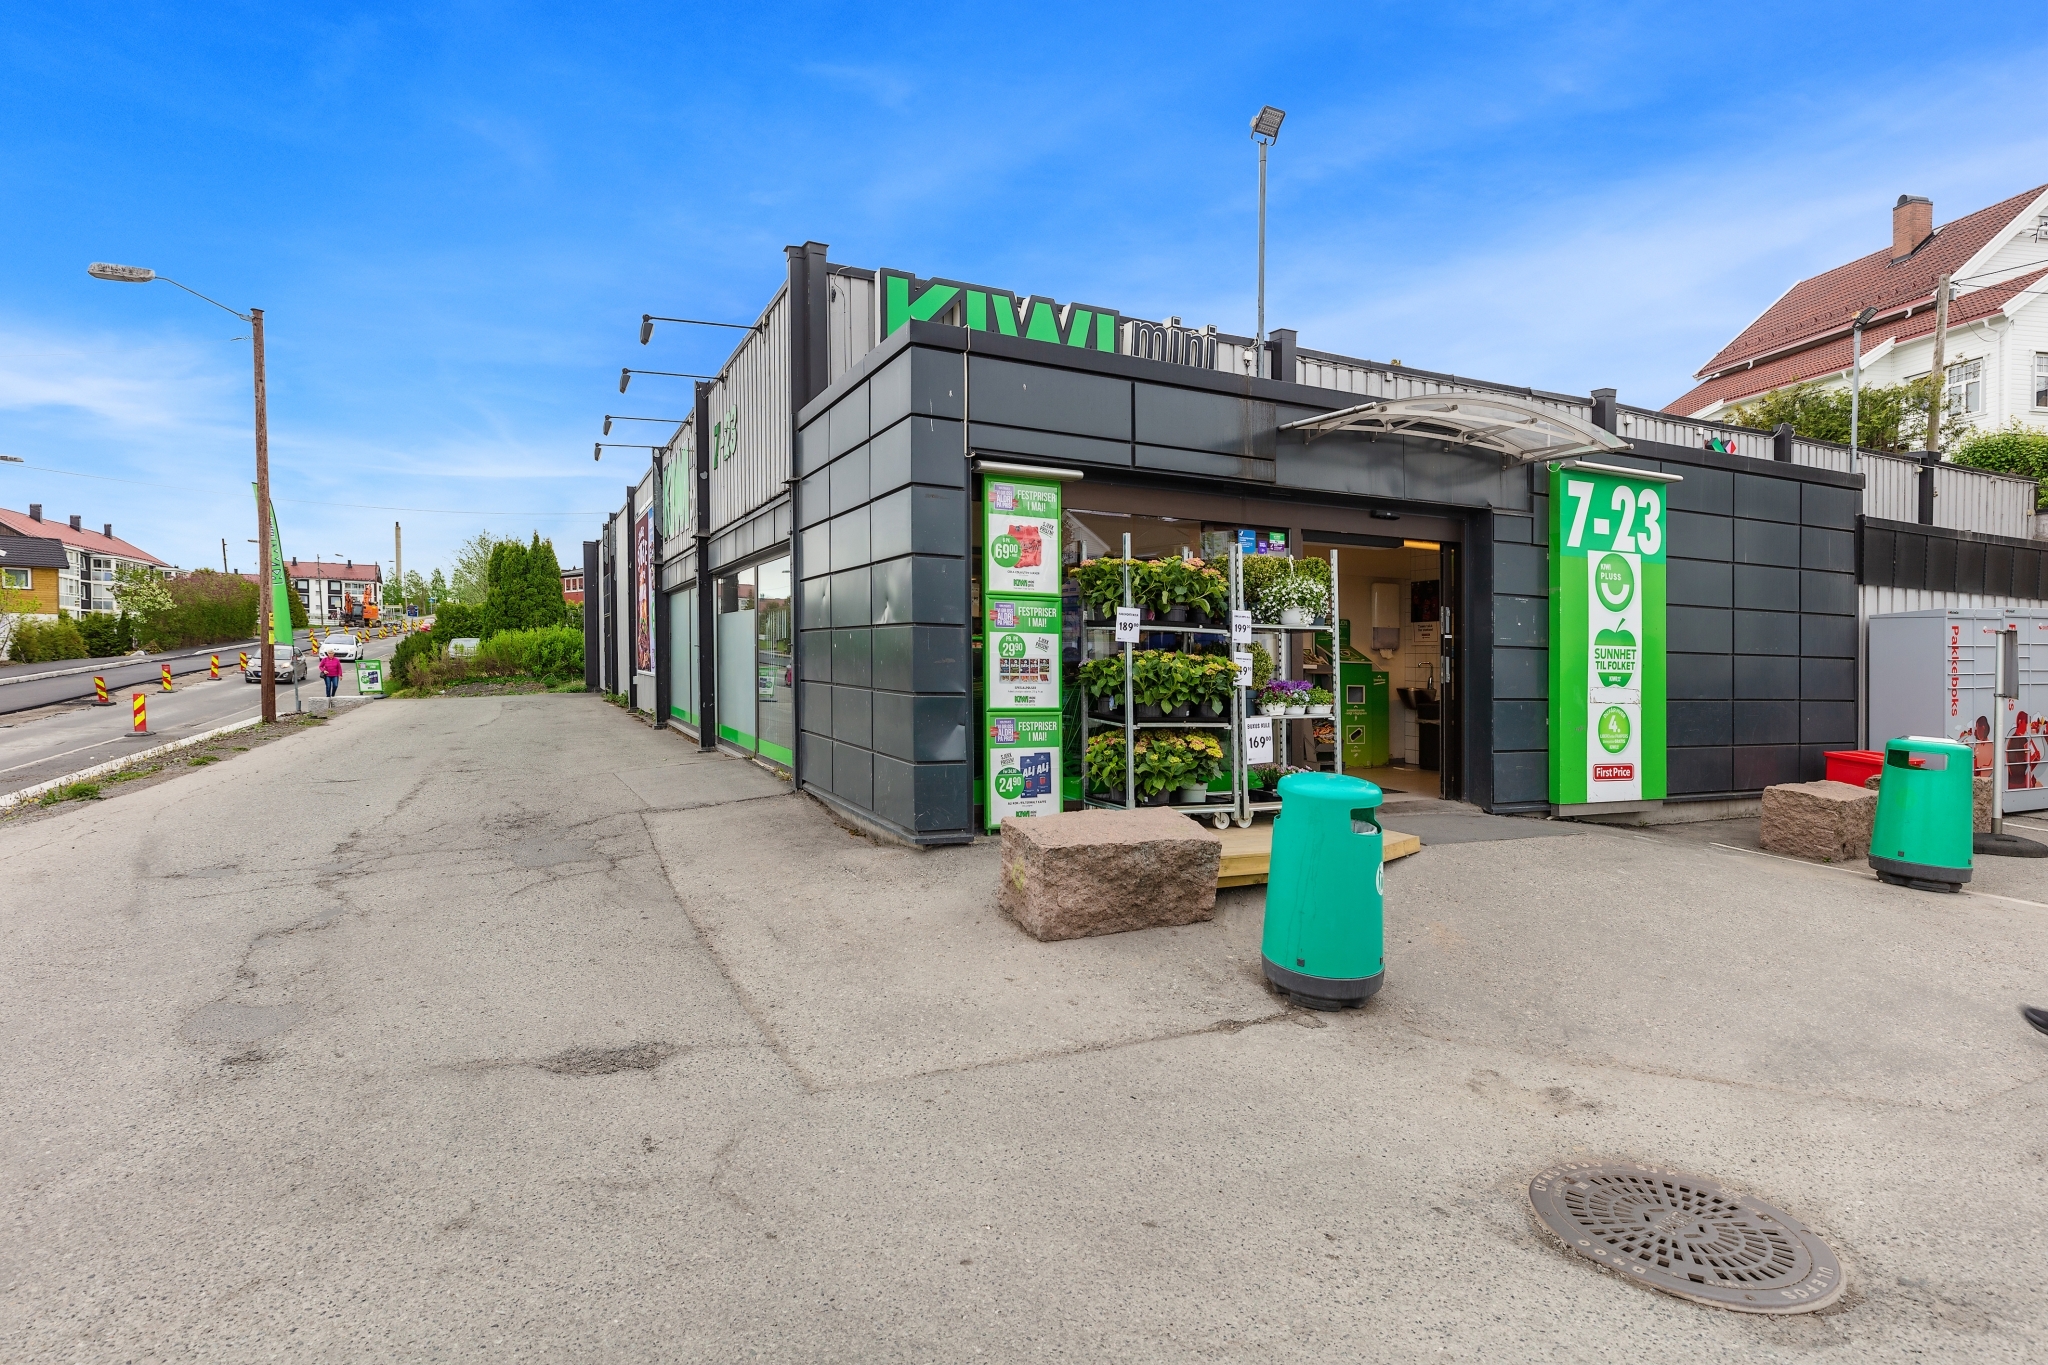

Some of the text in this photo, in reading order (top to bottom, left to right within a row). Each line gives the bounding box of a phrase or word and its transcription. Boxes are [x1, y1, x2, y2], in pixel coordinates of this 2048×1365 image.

[884, 270, 1117, 353] KIWI
[714, 404, 737, 470] 7-23
[1018, 490, 1056, 503] FESTPRISER
[1028, 502, 1045, 512] I MAI!
[1567, 480, 1662, 556] 7-23
[1601, 572, 1621, 580] PLUSS
[1018, 607, 1056, 617] FESTPRISER
[1029, 618, 1047, 627] I MAI!
[1595, 648, 1636, 660] SUNNHET
[1596, 661, 1636, 670] TIL FOLKET
[1019, 722, 1057, 731] FESTPRISER
[1609, 715, 1620, 733] 4.
[1029, 732, 1047, 741] I MAI!
[1596, 767, 1630, 777] First Price
[1578, 1240, 1646, 1274] D400
